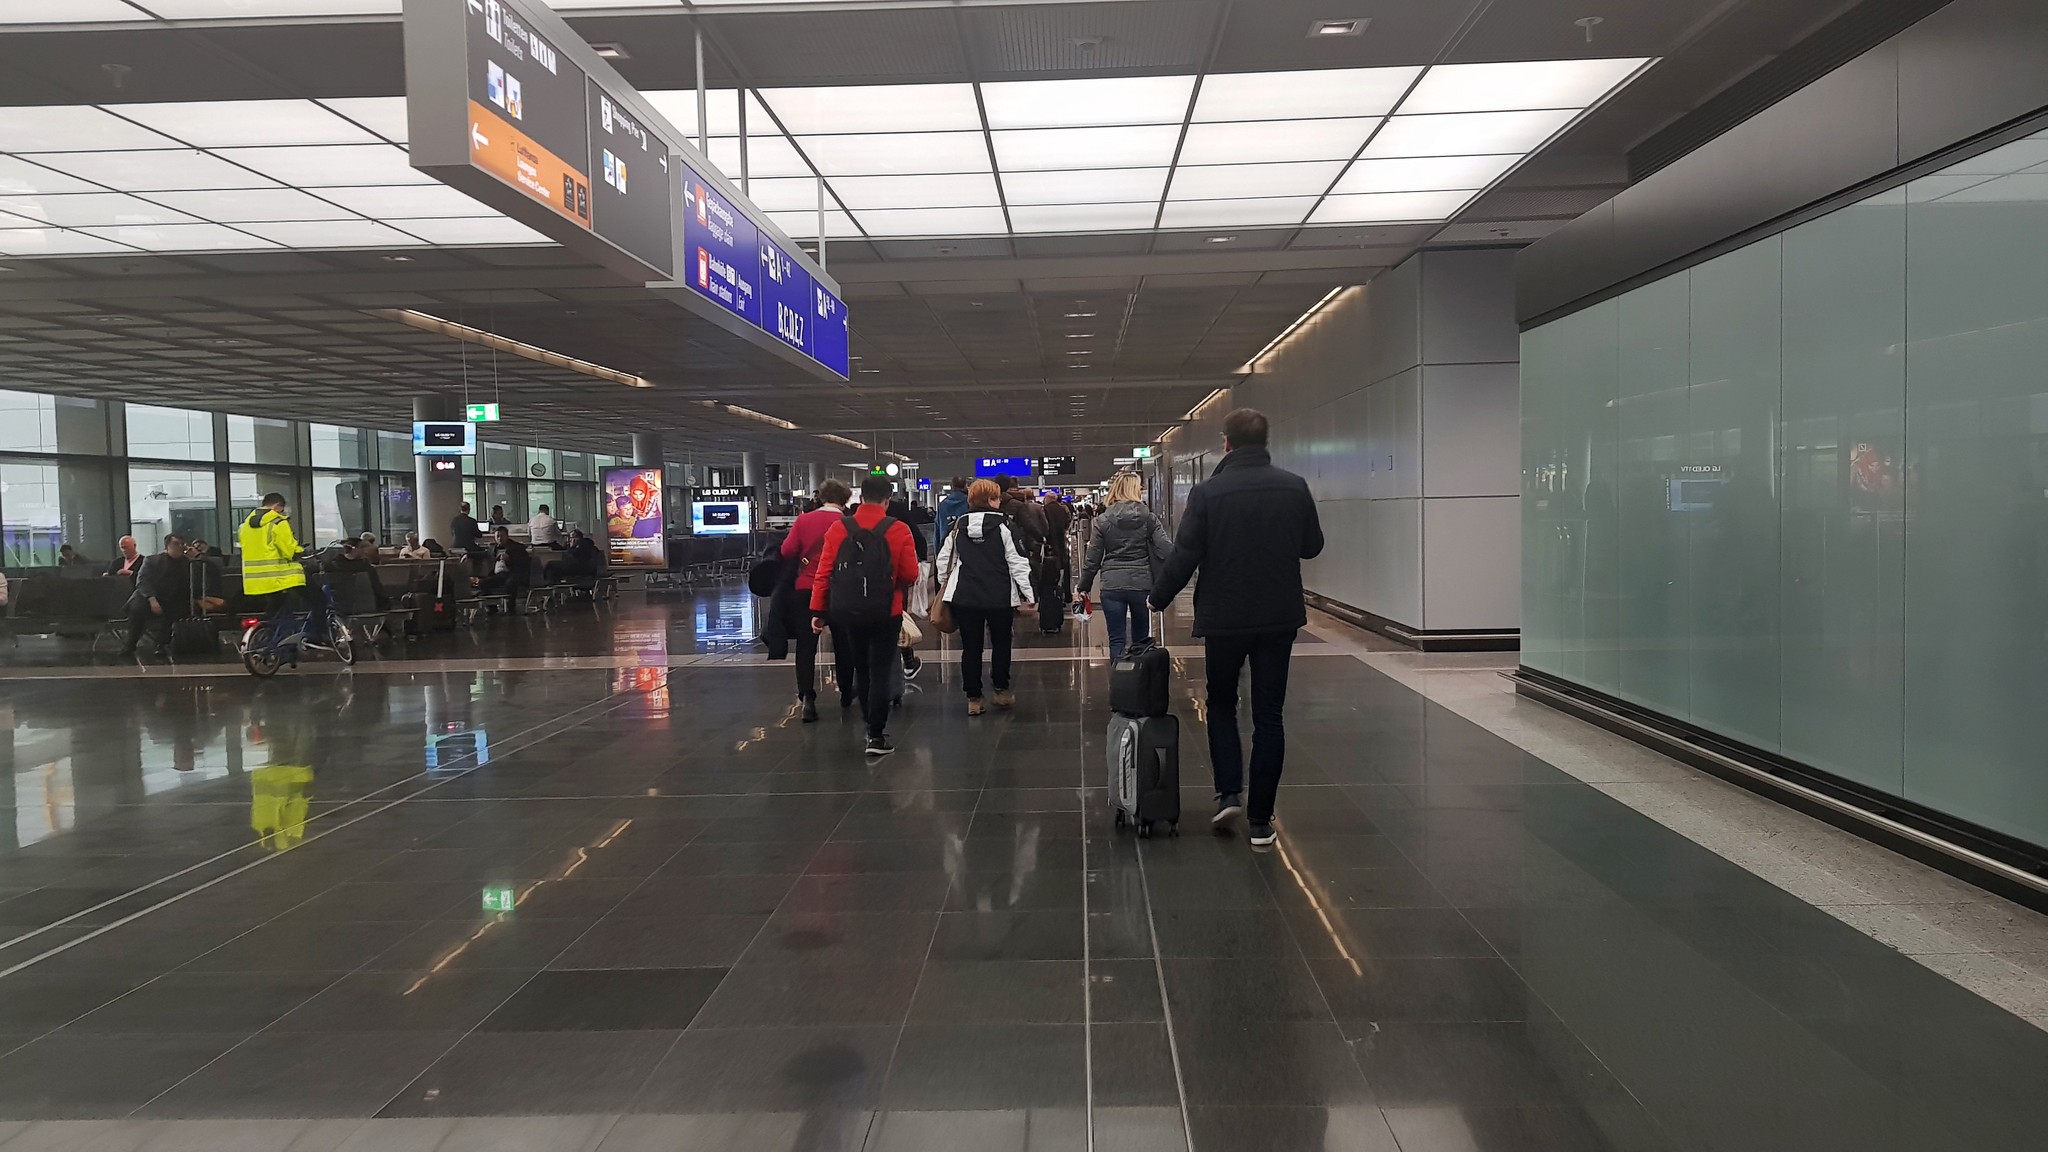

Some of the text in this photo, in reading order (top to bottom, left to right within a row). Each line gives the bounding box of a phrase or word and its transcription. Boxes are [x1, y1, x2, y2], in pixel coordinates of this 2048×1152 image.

[503, 32, 524, 61] Toilets
[612, 104, 632, 135] Shopping
[709, 276, 719, 295] Train
